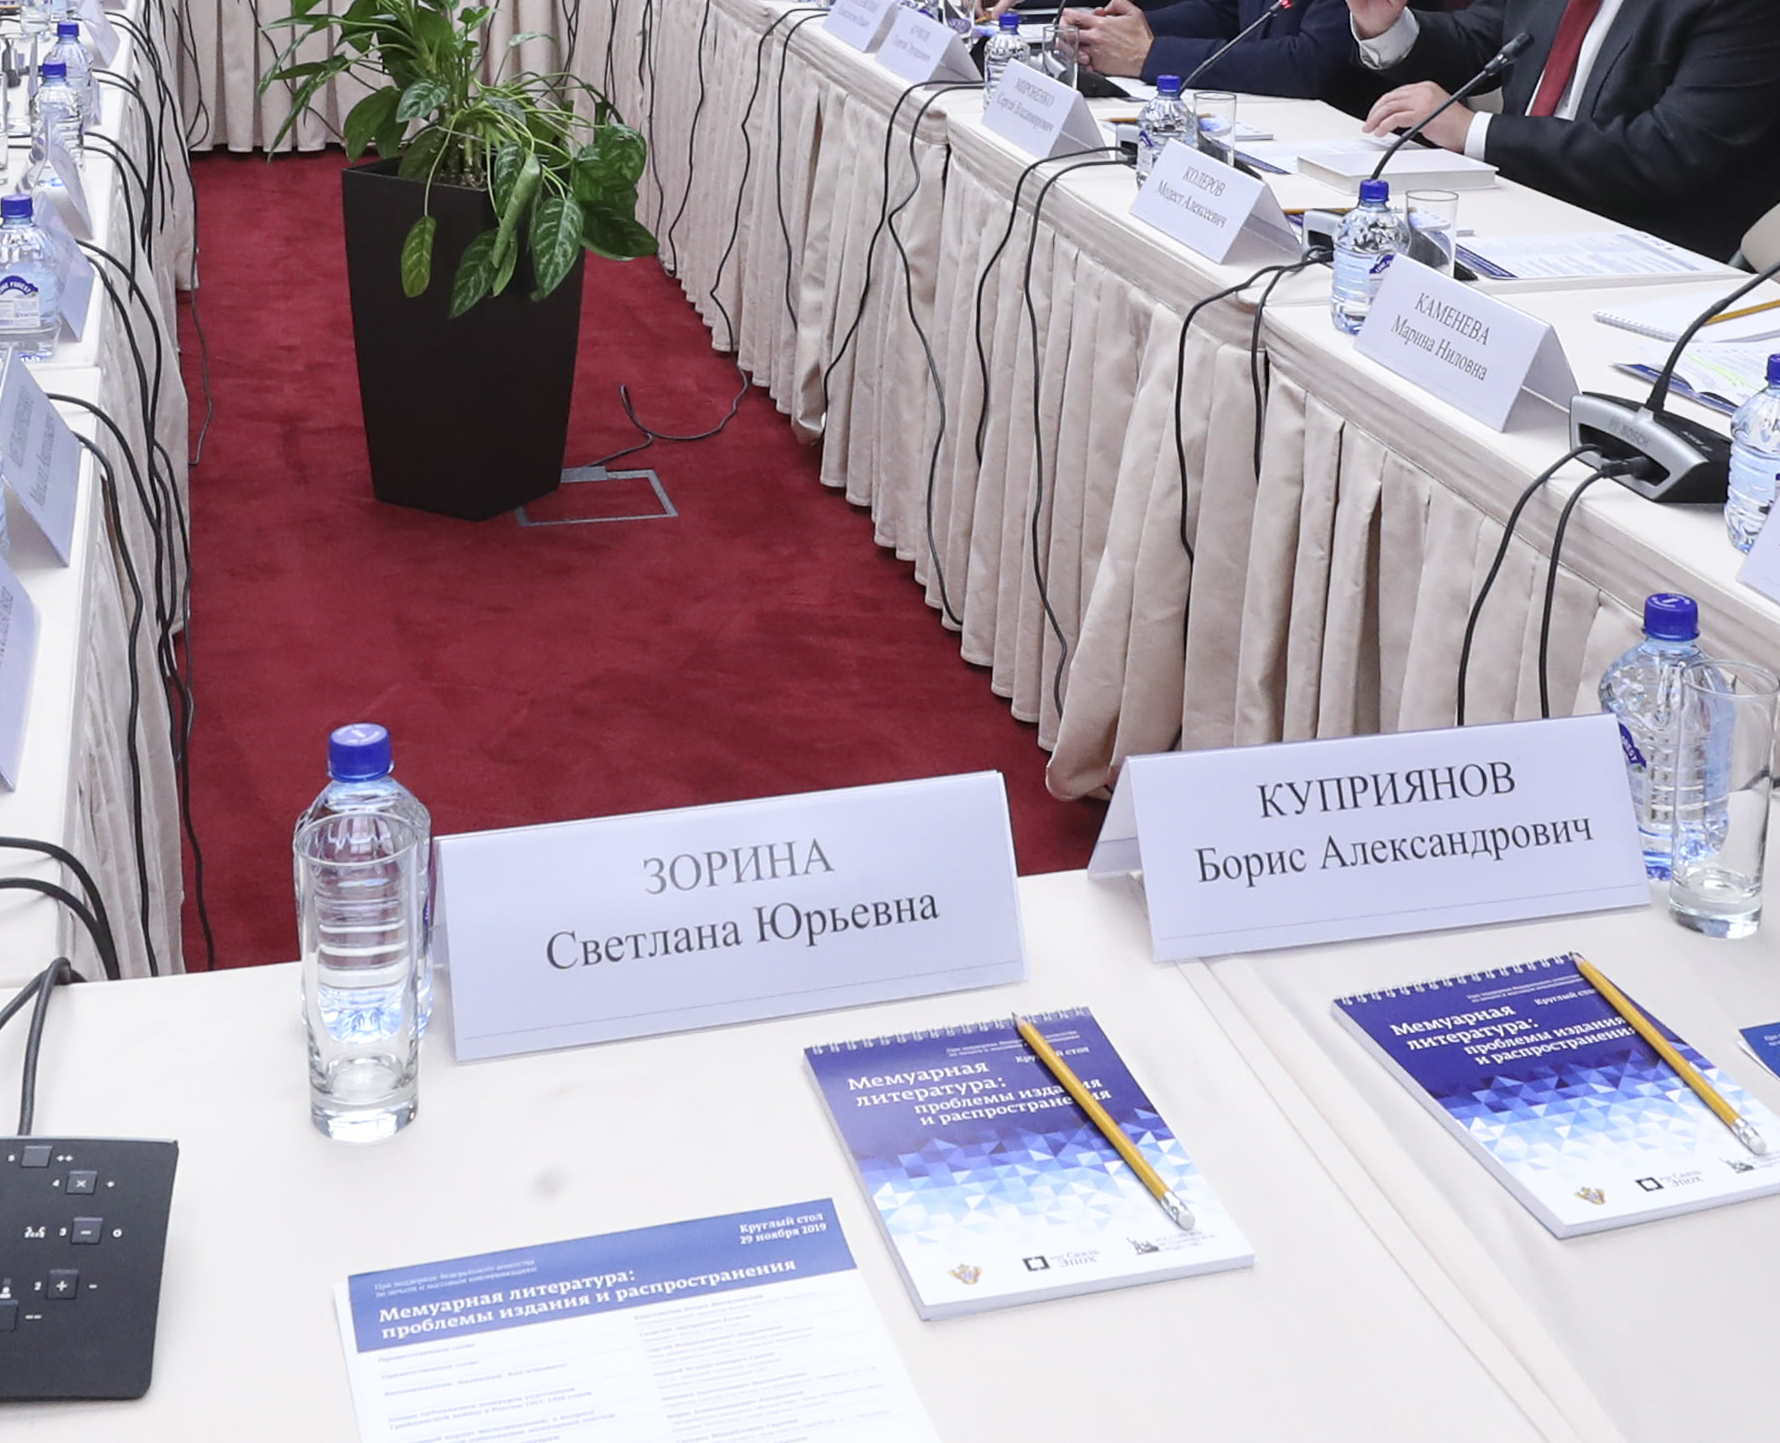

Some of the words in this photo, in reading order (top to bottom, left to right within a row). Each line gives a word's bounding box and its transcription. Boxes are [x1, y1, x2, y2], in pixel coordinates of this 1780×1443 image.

[1182, 166, 1226, 197] КОЛЕРОВ
[1157, 180, 1184, 207] Модест
[1183, 198, 1227, 228] Алексеевич
[1414, 293, 1491, 346] КАМЕНЕВА
[1390, 315, 1436, 352] Марина
[1435, 336, 1488, 381] Ниловна
[1256, 761, 1517, 819] КУПРИЯНОВ
[641, 836, 836, 896] ЗОРИНА
[1194, 842, 1308, 888] Борис
[1319, 814, 1595, 872] Александрович
[545, 919, 743, 974] Светлана
[756, 887, 941, 954] Юрьевна
[1390, 1005, 1516, 1036] Мемуарная
[1406, 1018, 1539, 1050] литература:
[1463, 1031, 1550, 1055] проблемы
[847, 1061, 990, 1092] Мемуарная
[1475, 1056, 1490, 1066] и
[855, 1076, 1007, 1107] литература:
[914, 1091, 1014, 1114] проблемы
[920, 1116, 934, 1126] и
[739, 1216, 792, 1234] Круглый
[794, 1213, 823, 1227] стол
[739, 1234, 753, 1244] 29
[756, 1226, 800, 1244] ноября
[802, 1222, 827, 1235] 2019
[378, 1291, 504, 1323] Мемуарная
[509, 1269, 636, 1305] литература:
[381, 1312, 493, 1341] проблемы
[498, 1295, 591, 1319] издания
[597, 1288, 611, 1302] и
[616, 1258, 797, 1303] распространения
